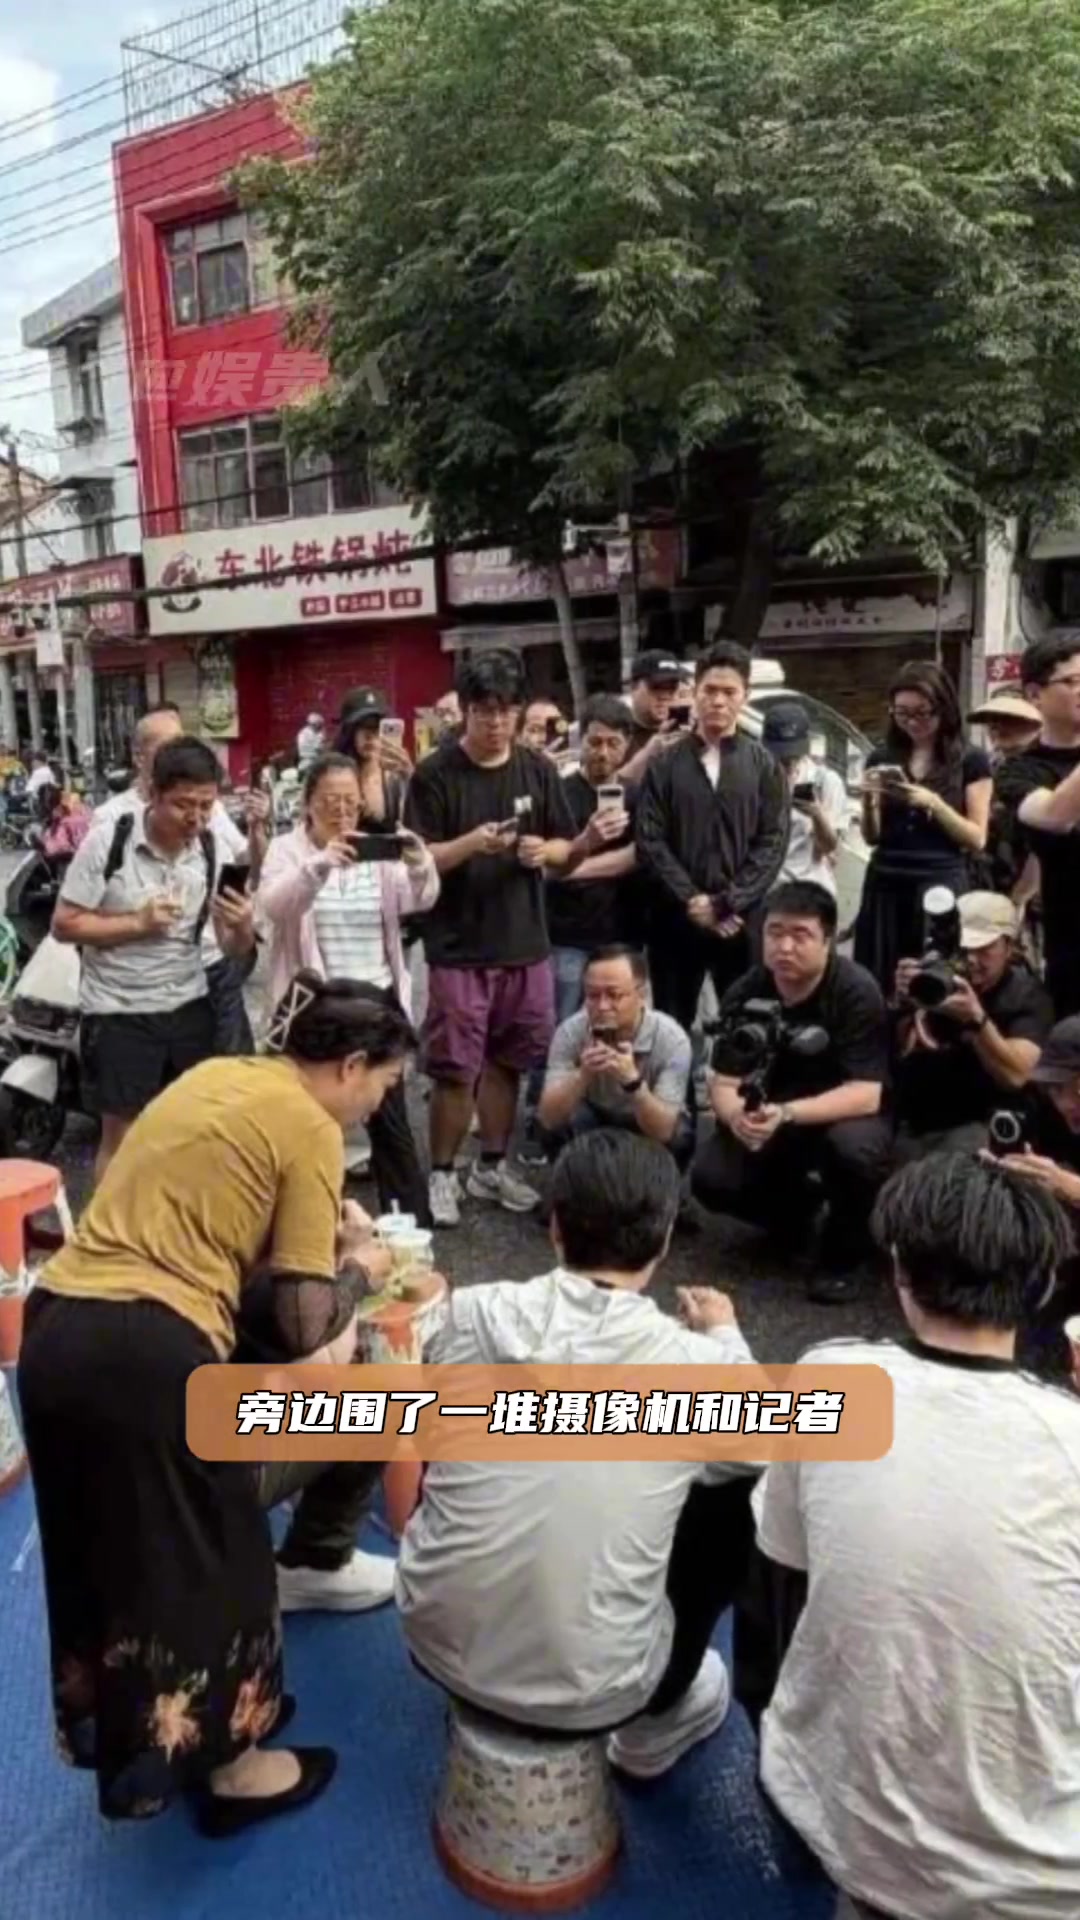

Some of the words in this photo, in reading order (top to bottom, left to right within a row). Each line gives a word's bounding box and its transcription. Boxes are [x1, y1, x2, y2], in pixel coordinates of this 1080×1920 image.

[215, 529, 411, 590] 东北铁锅炖
